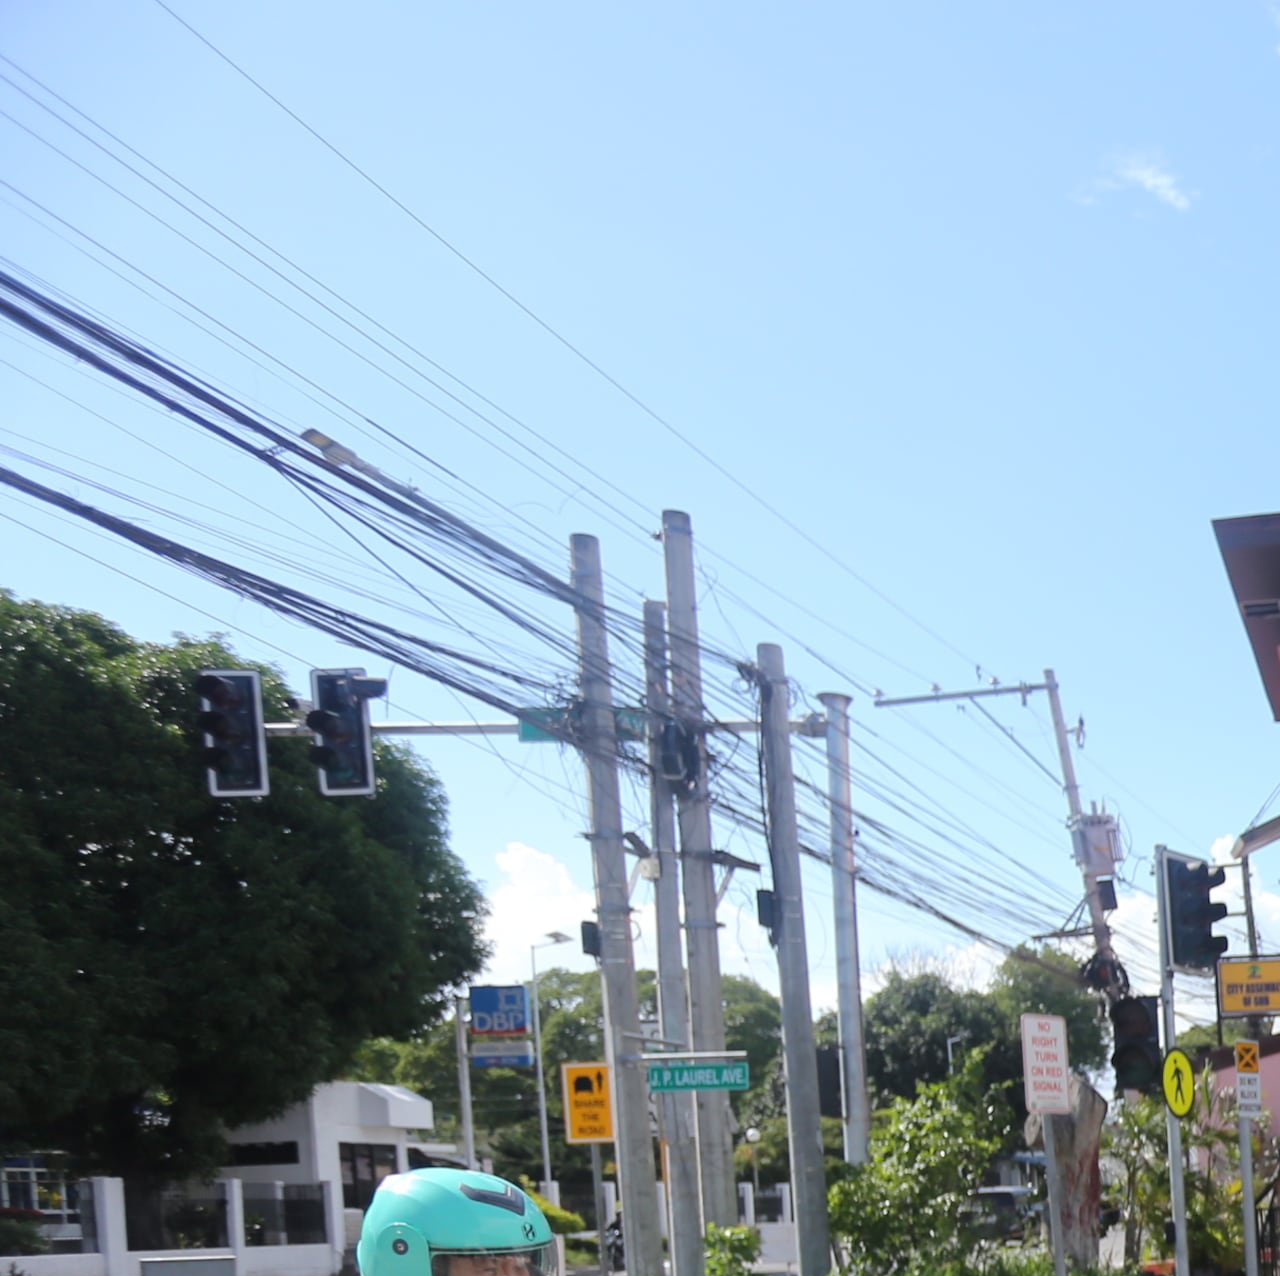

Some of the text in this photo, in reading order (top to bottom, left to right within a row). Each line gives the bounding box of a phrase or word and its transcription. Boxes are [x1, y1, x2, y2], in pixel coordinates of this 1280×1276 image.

[473, 1011, 524, 1031] DBP
[1038, 1022, 1050, 1033] NO
[1032, 1036, 1057, 1047] RIGHT
[1035, 1051, 1058, 1062] TURN
[1032, 1066, 1063, 1077] ON RED
[651, 1073, 661, 1087] J.
[663, 1073, 674, 1086] P.
[675, 1070, 720, 1086] LAUREL
[1033, 1081, 1063, 1092] SIGNAL
[574, 1100, 606, 1109] SHARE
[582, 1113, 600, 1122] THE
[579, 1126, 606, 1136] ROAD
